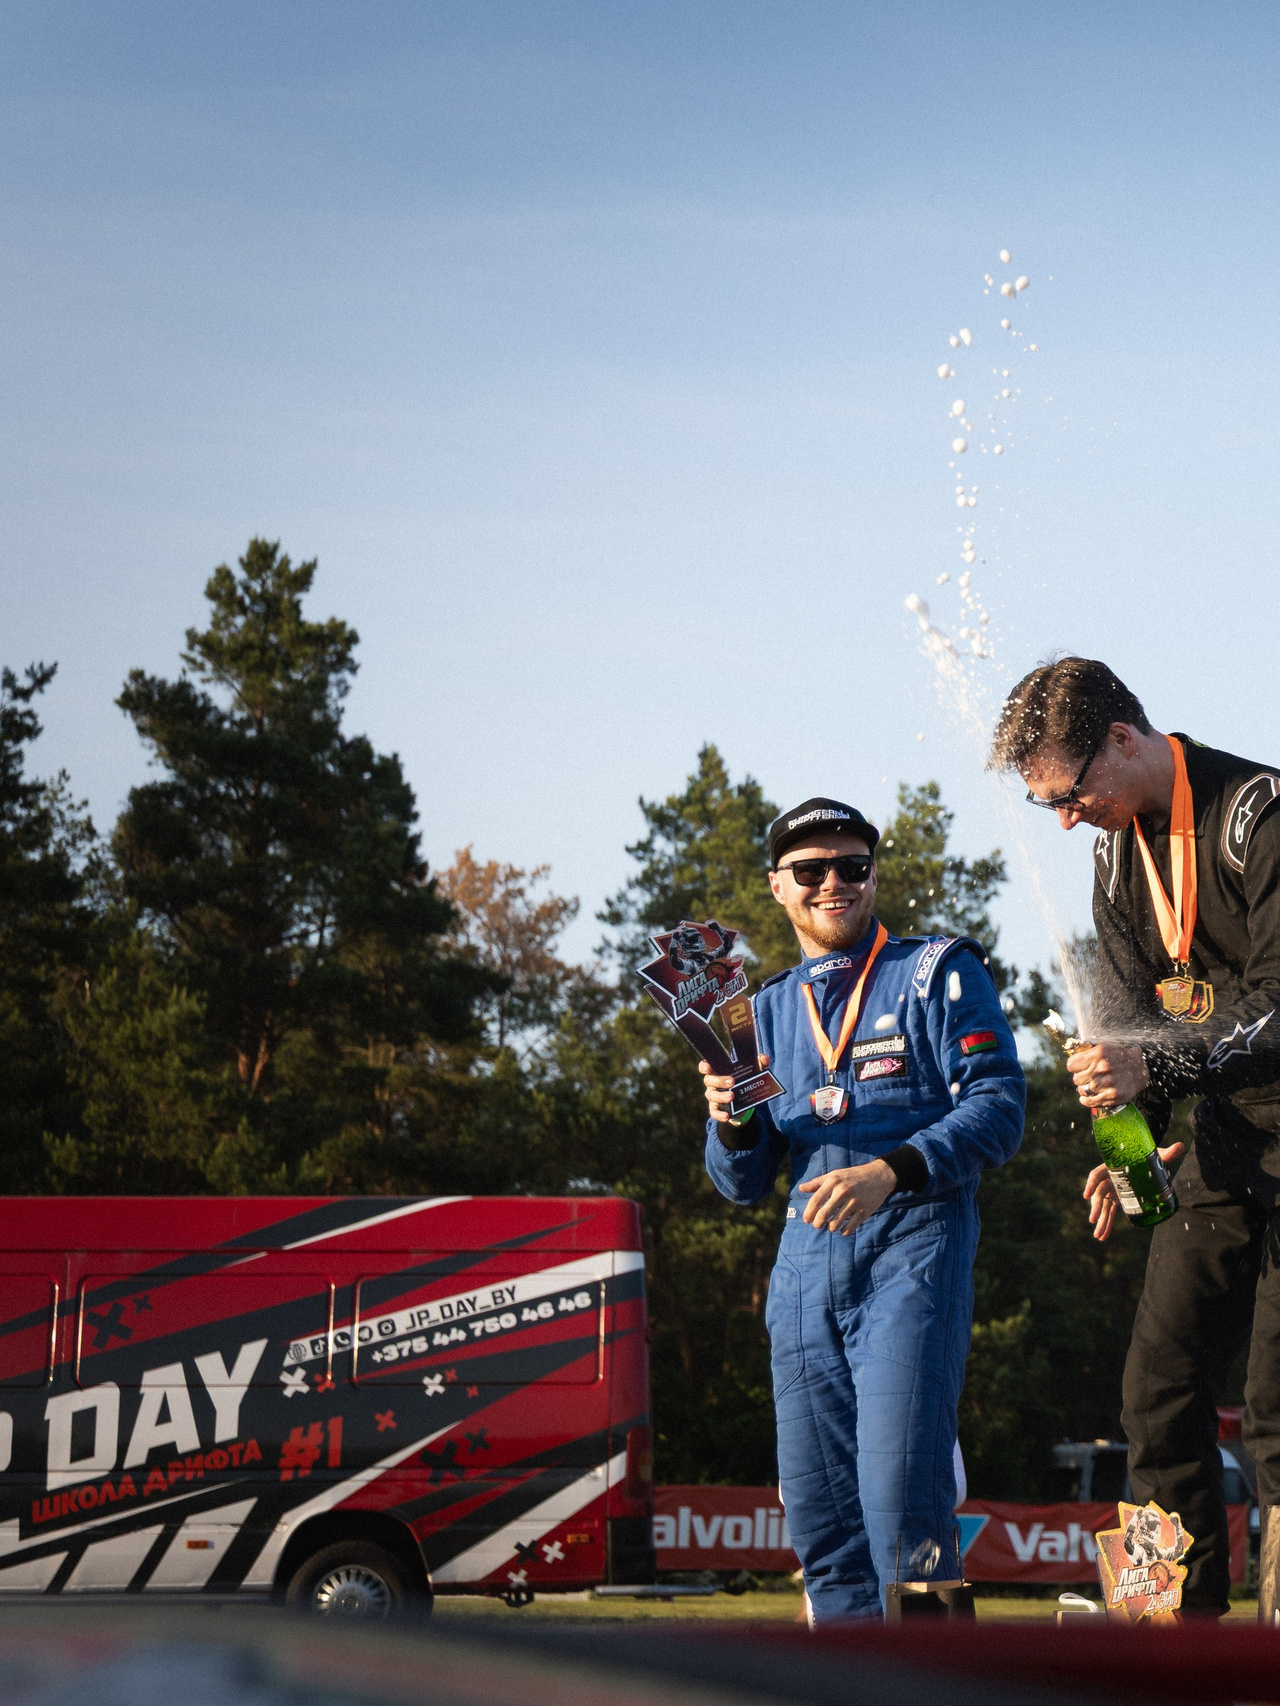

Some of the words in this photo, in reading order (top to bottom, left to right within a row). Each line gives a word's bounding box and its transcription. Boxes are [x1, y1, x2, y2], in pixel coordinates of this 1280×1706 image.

[810, 955, 852, 977] sparco
[916, 943, 945, 981] sparco
[677, 971, 708, 997] ЛИГА
[729, 1002, 748, 1026] 2
[744, 1080, 765, 1093] МЕСТО
[405, 1285, 518, 1331] JP_DAY_BY
[371, 1336, 429, 1363] +375
[432, 1326, 467, 1347] 44
[469, 1312, 518, 1337] 750
[521, 1301, 555, 1323] 46
[557, 1291, 592, 1313] 46
[44, 1338, 268, 1491] DAY
[31, 1474, 137, 1523] ШКОЛА
[143, 1438, 262, 1497] ДРИФТА
[279, 1416, 343, 1482] #1
[1004, 1522, 1100, 1562] Valv
[1111, 1579, 1157, 1604] ДРИФТА
[1118, 1566, 1149, 1586] ЛИГА
